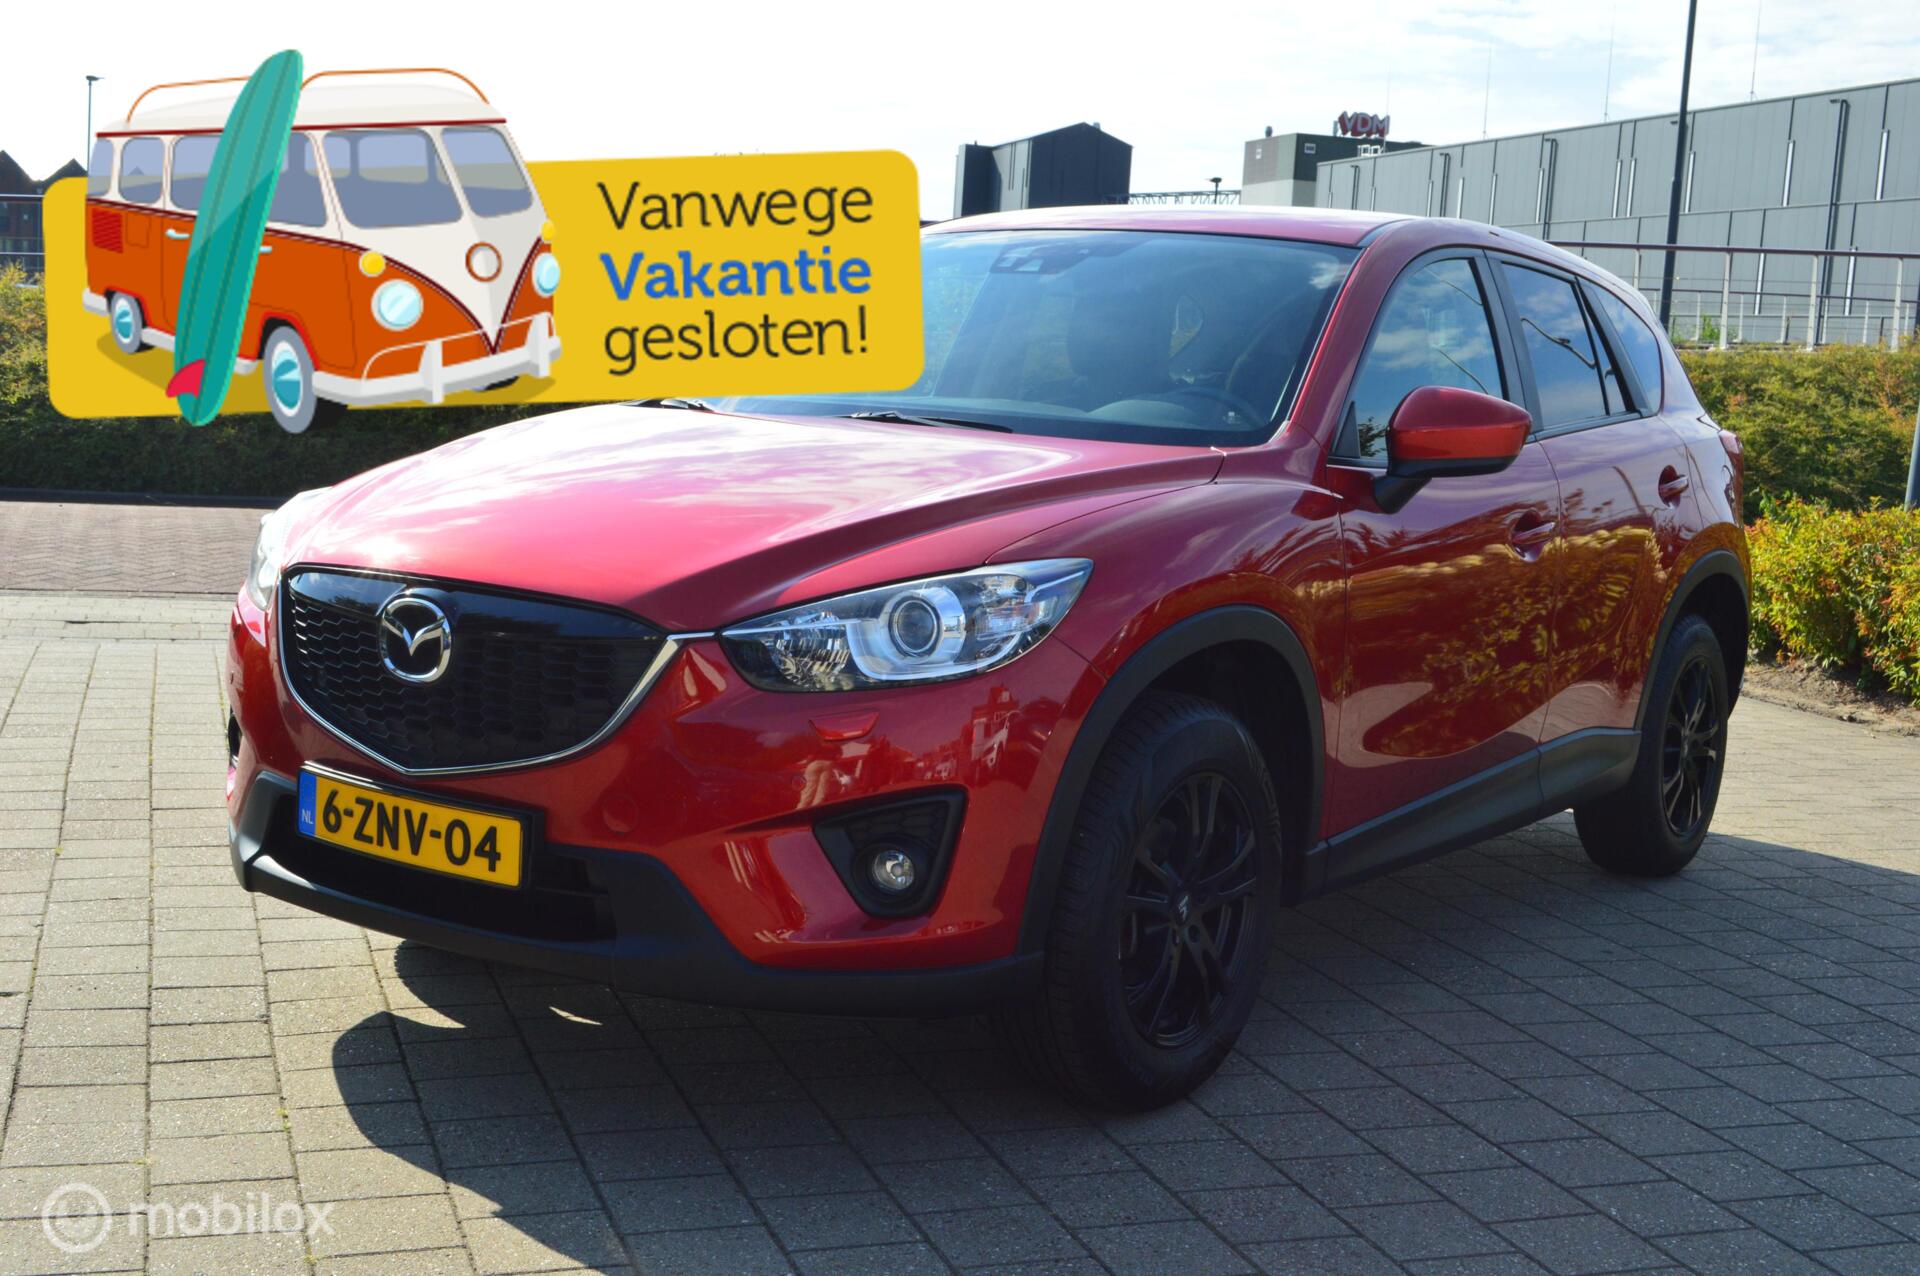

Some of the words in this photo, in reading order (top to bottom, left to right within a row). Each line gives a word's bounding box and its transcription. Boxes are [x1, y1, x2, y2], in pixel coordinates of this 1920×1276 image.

[1338, 110, 1390, 137] VDM
[301, 808, 314, 825] NL
[322, 788, 502, 873] 6-ZNV-04
